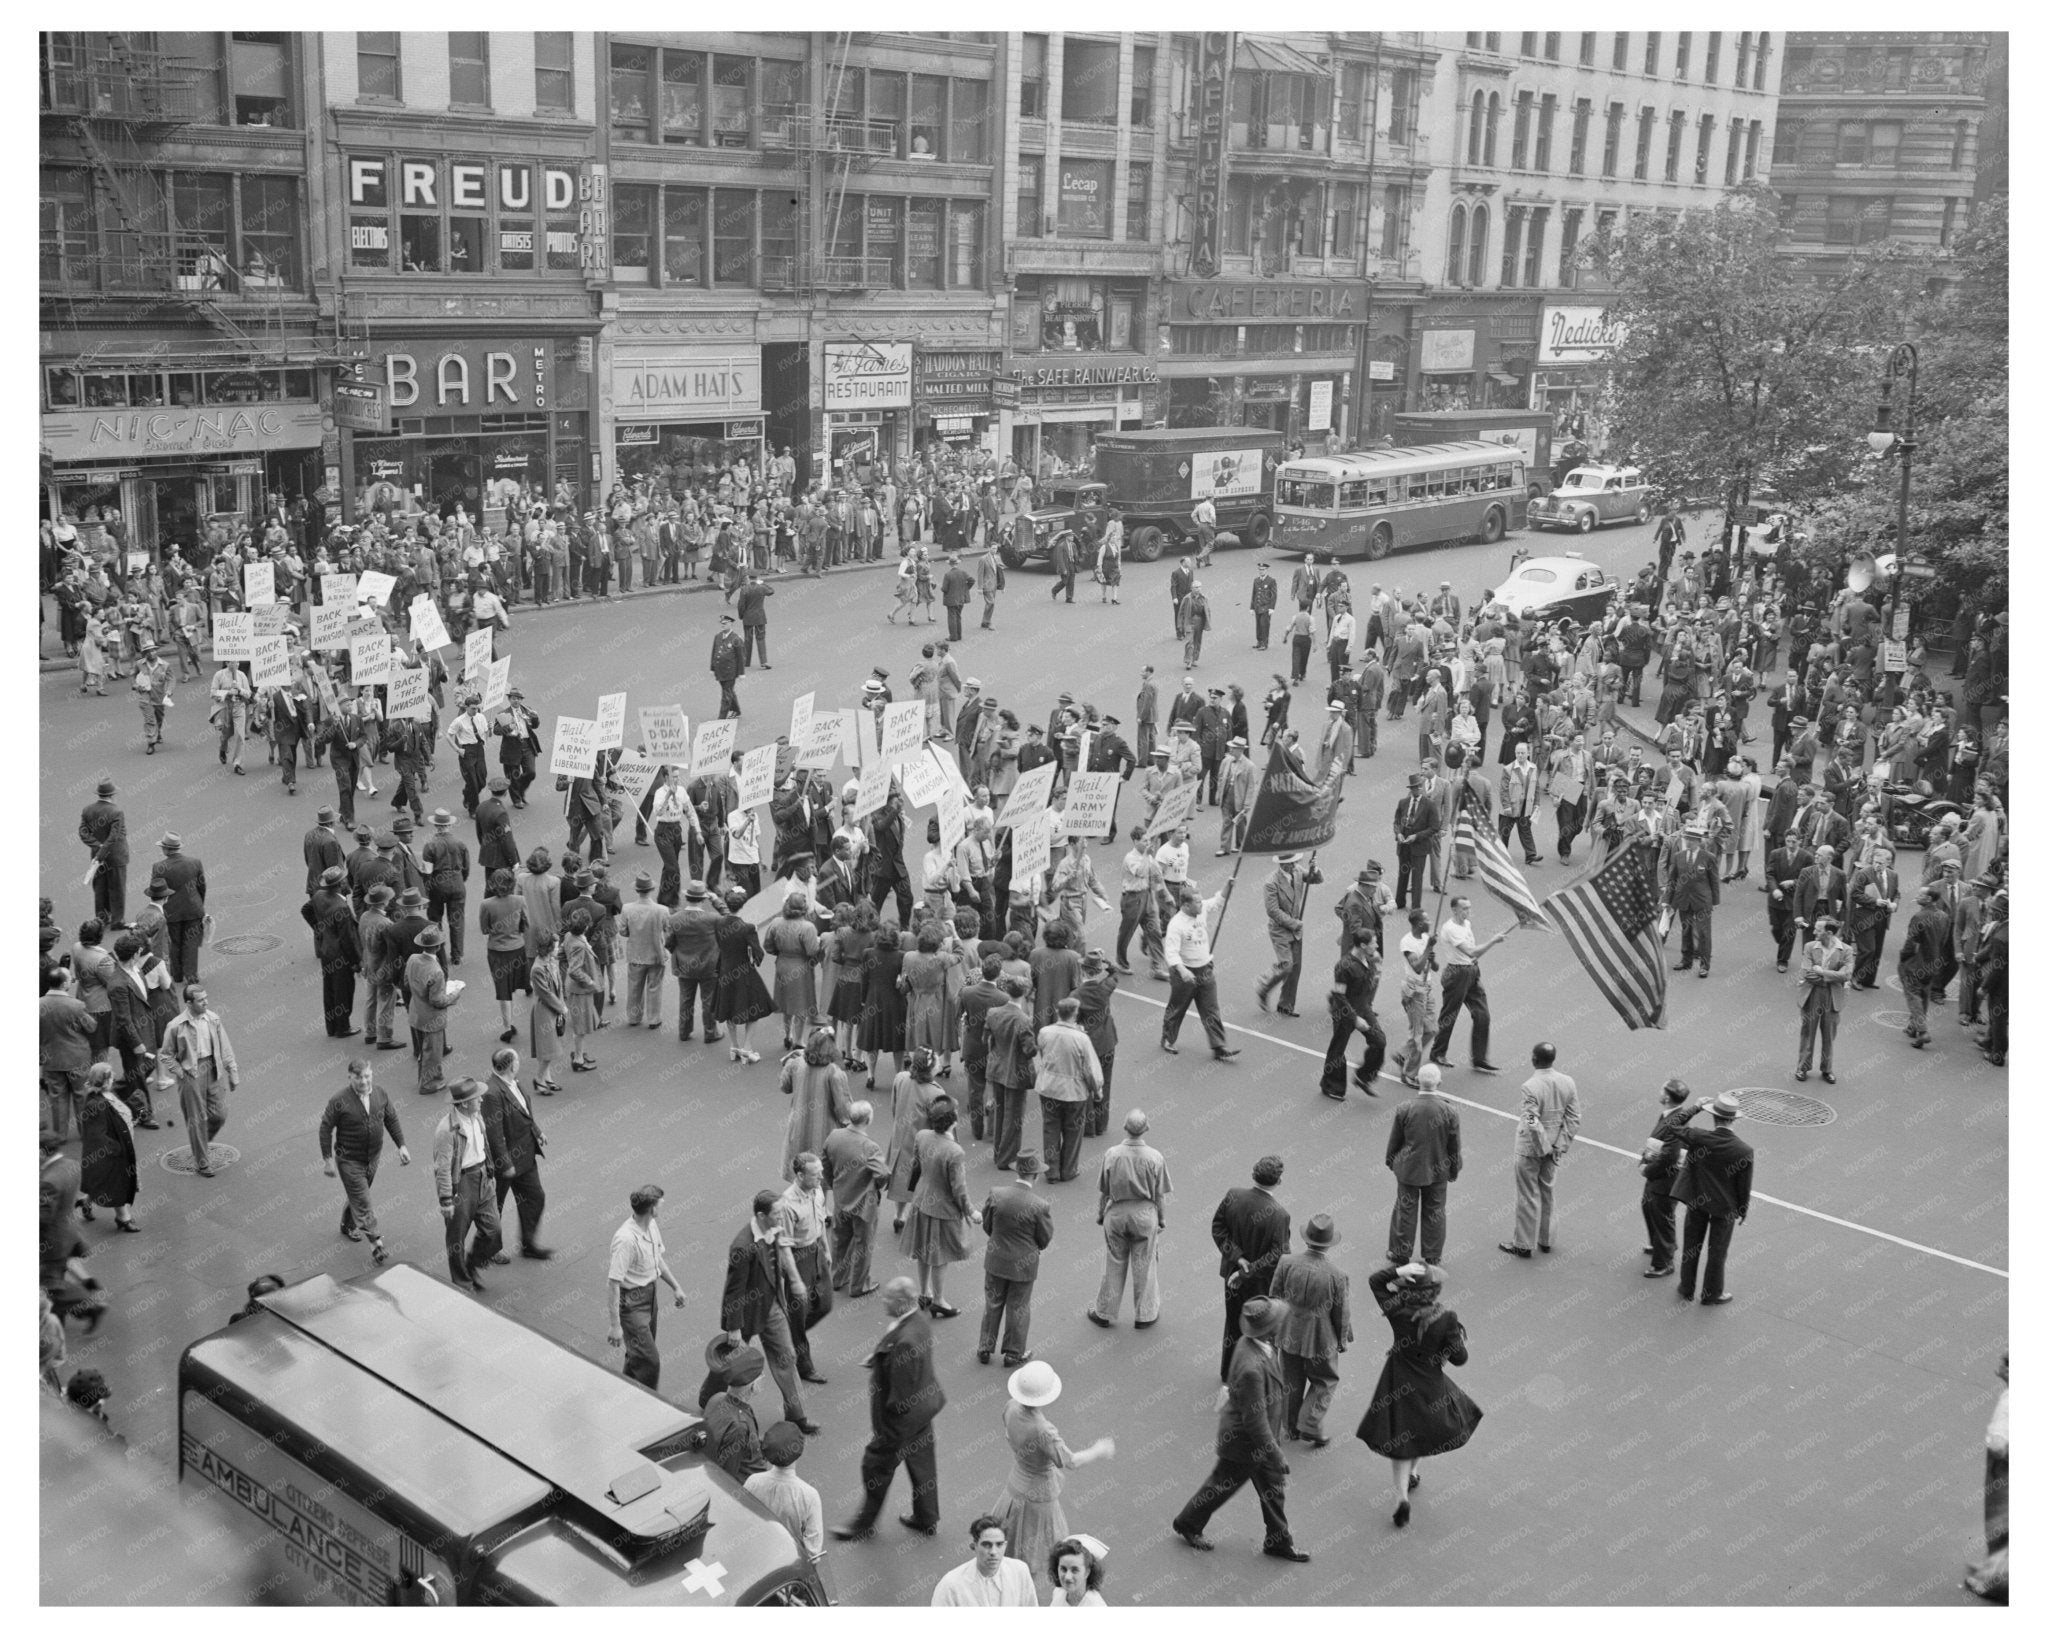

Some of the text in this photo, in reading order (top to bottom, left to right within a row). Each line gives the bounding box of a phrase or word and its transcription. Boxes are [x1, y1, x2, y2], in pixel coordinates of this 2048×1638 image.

[351, 160, 574, 209] FREUD
[1062, 172, 1098, 194] Lecap
[579, 174, 593, 269] BAR
[869, 208, 893, 217] UNIT
[501, 232, 532, 249] ARTISTS
[547, 232, 578, 253] PHOTOS
[1187, 288, 1353, 317] CAFETERIA
[925, 353, 993, 373] HADDON HALL
[386, 351, 519, 407] BAR
[534, 347, 545, 408] METRO
[630, 372, 744, 399] ADAM HATS
[1037, 368, 1070, 386] SAFE
[1074, 366, 1140, 385] RAINWEAR
[827, 381, 909, 399] RESTAURANT
[925, 382, 991, 395] MALTED MILK
[91, 410, 285, 442] NIC-NAC
[559, 419, 570, 429] 14
[217, 615, 247, 630] Hail!
[316, 609, 342, 624] BACK
[350, 620, 376, 636] BACK
[217, 648, 250, 656] LIBERATION
[255, 640, 280, 657] BACK
[358, 639, 384, 656] BACK
[255, 662, 288, 682] INVASION
[355, 661, 389, 681] INVASION
[393, 672, 422, 691] BACK
[389, 694, 426, 714] INVASION
[653, 719, 673, 728] HAIL
[812, 718, 843, 734] BACK
[890, 705, 918, 729] BACK
[560, 722, 595, 738] Hail!
[648, 728, 680, 740] D-DAY
[702, 723, 730, 744] BACK
[558, 744, 590, 756] ARMY
[651, 741, 684, 751] V-DAY
[800, 743, 838, 761] INVASION
[885, 732, 921, 756] INVASION
[554, 758, 591, 772] LIBERATION
[746, 747, 772, 768] Hail!
[616, 763, 657, 774] INVASION
[744, 773, 769, 787] ARMY
[1016, 775, 1046, 795] BACK
[1073, 775, 1111, 794] Hail!
[741, 787, 770, 804] LIBERATION
[1070, 803, 1107, 812] ARMY
[1015, 815, 1044, 845] Hail!
[1066, 819, 1106, 829] LIBERATION
[1018, 842, 1044, 863] ARMY
[1015, 855, 1047, 880] LIBERATION
[201, 1451, 363, 1586] AMBULANCE
